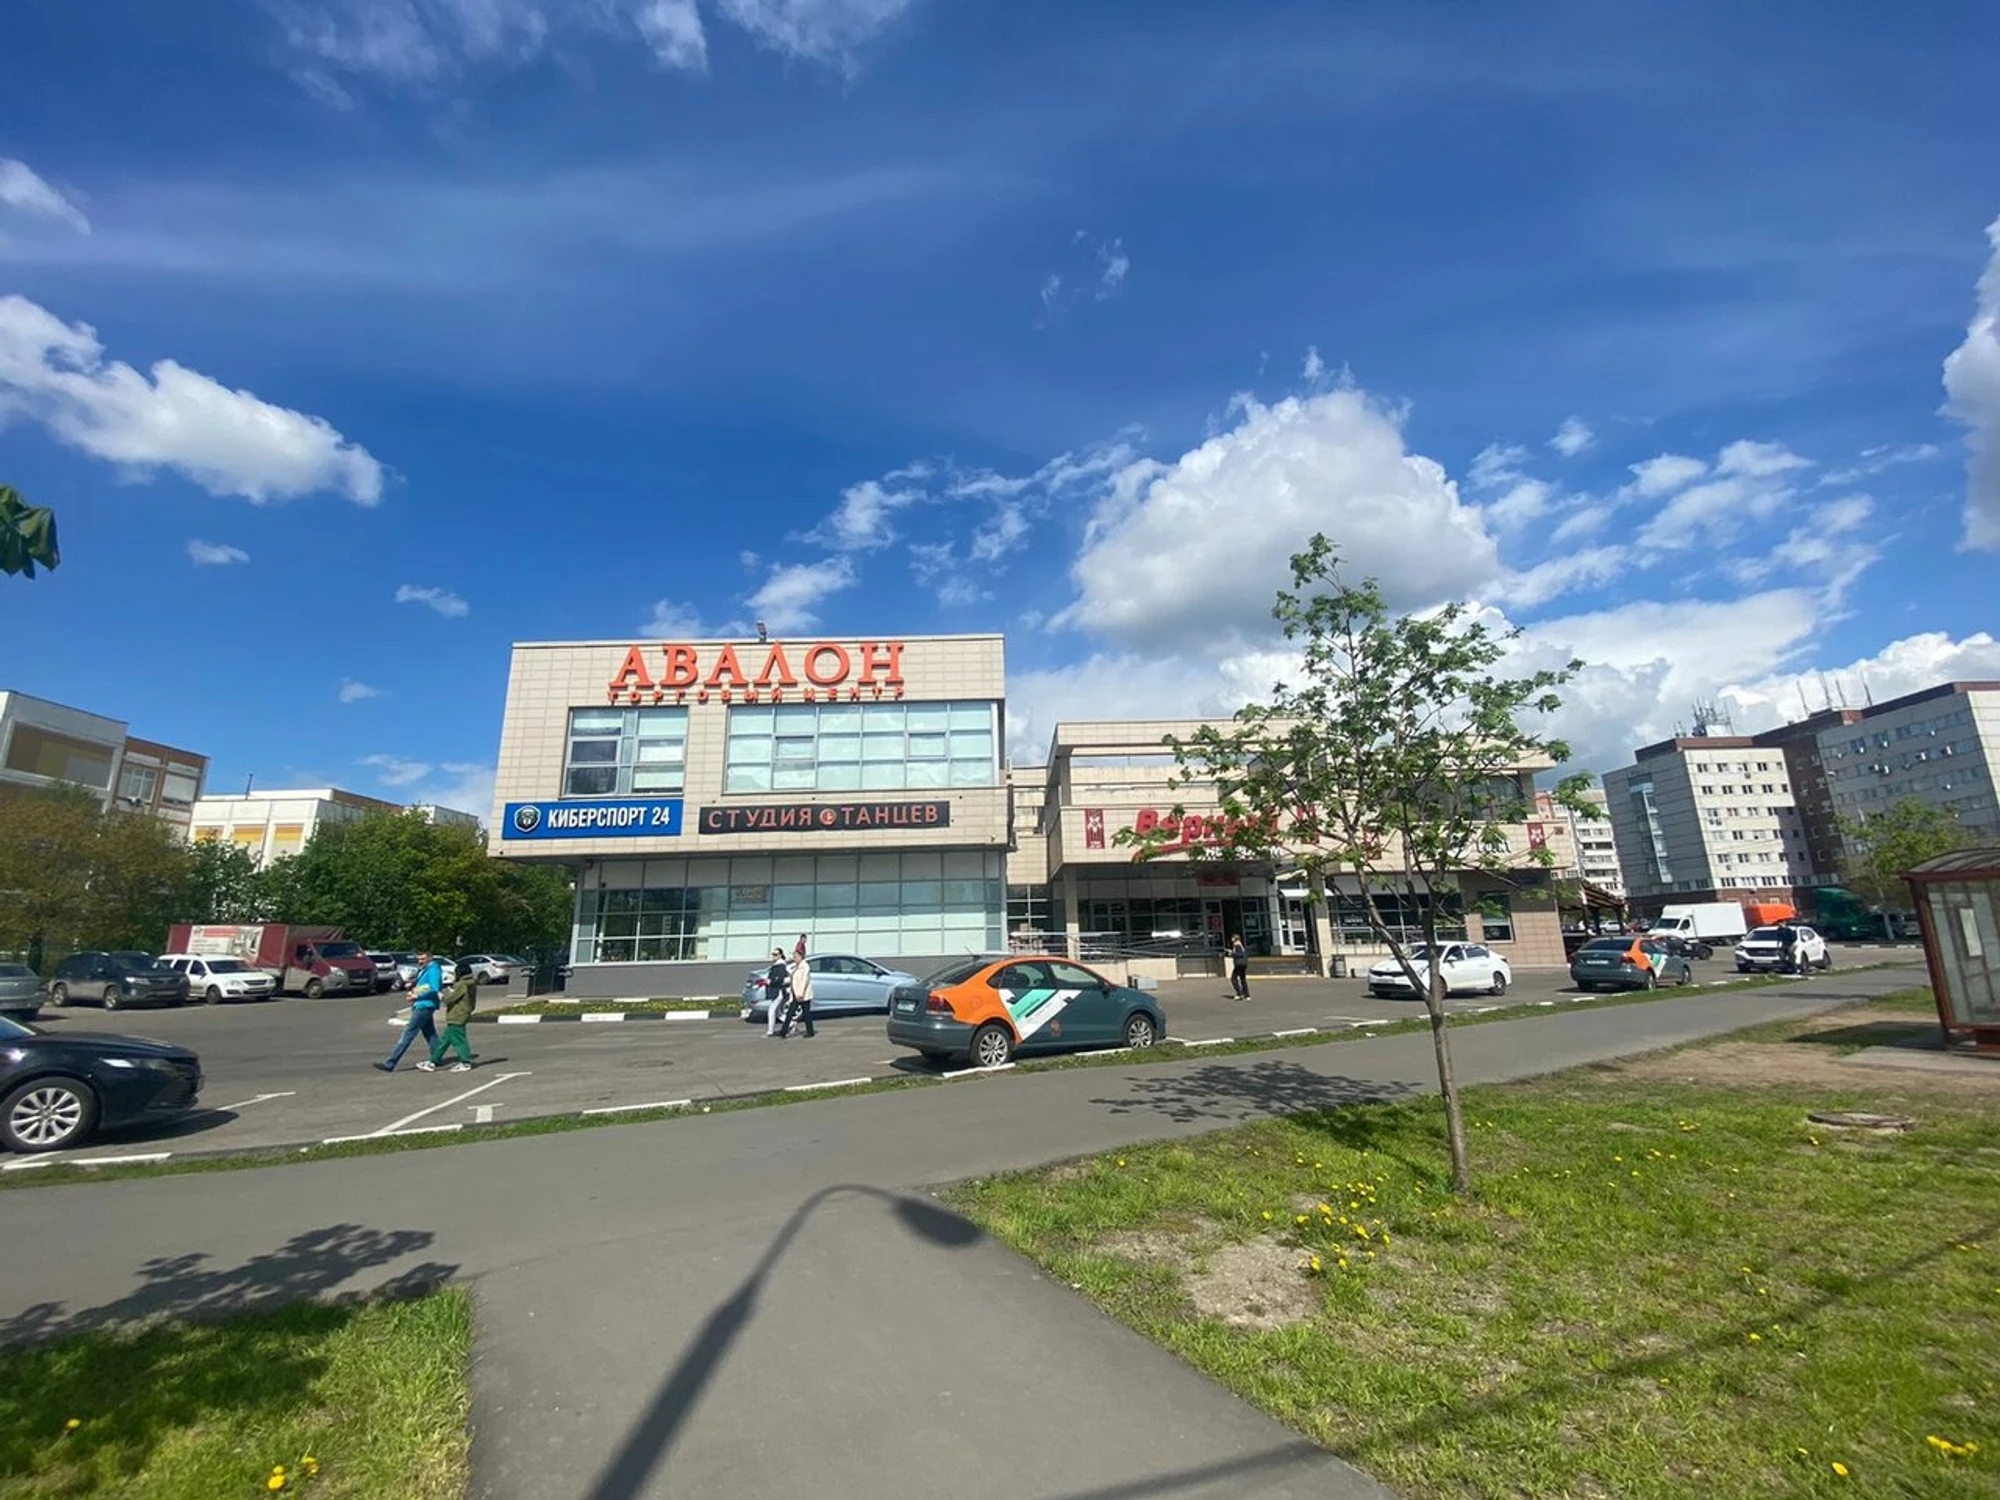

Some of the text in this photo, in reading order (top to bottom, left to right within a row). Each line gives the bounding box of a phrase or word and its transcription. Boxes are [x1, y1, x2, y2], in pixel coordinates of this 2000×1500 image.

[608, 640, 905, 687] АВАЛОН
[607, 686, 905, 705] ТОРГОВЫЙ ЦЕНТР
[547, 806, 671, 828] КИБЕРСПОРТ 24
[708, 804, 939, 829] СТУДИЯ ТАНЦЕВ
